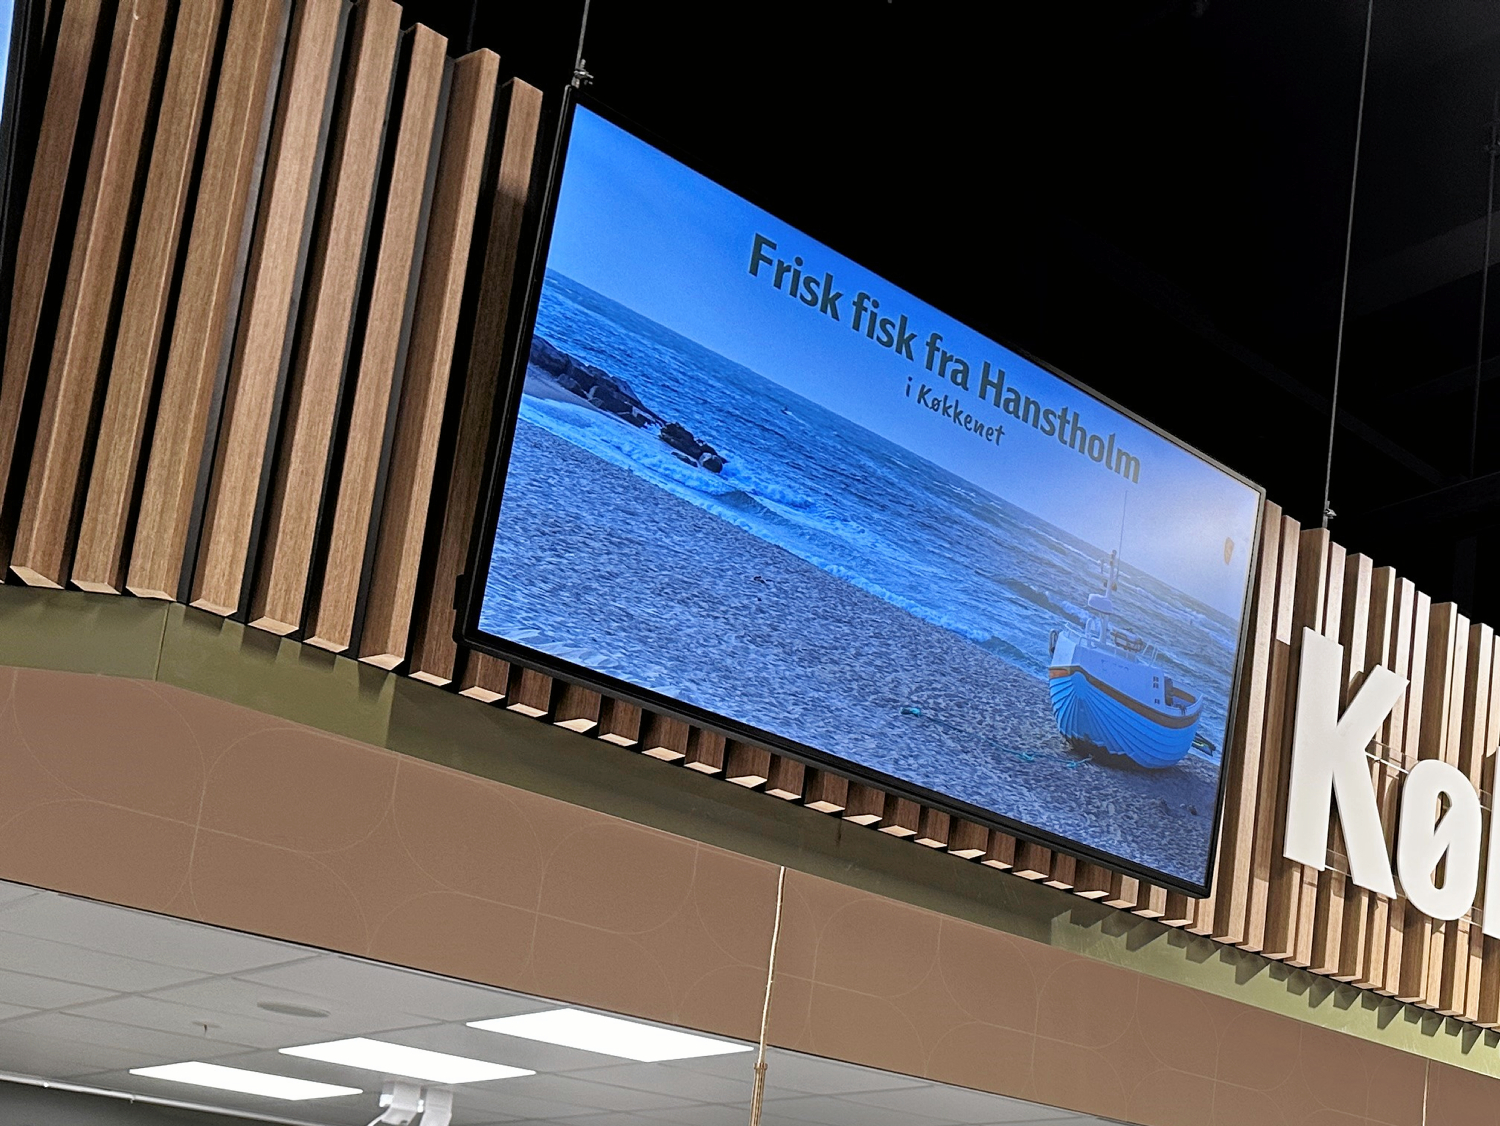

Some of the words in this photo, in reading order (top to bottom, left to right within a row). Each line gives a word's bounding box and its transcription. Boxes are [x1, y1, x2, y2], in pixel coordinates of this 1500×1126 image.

[747, 232, 842, 321] Frisk
[852, 292, 918, 362] fisk
[922, 333, 970, 393] fra
[978, 360, 1142, 484] Hanstholm
[905, 377, 914, 400] i
[916, 384, 1007, 447] Køkkenet
